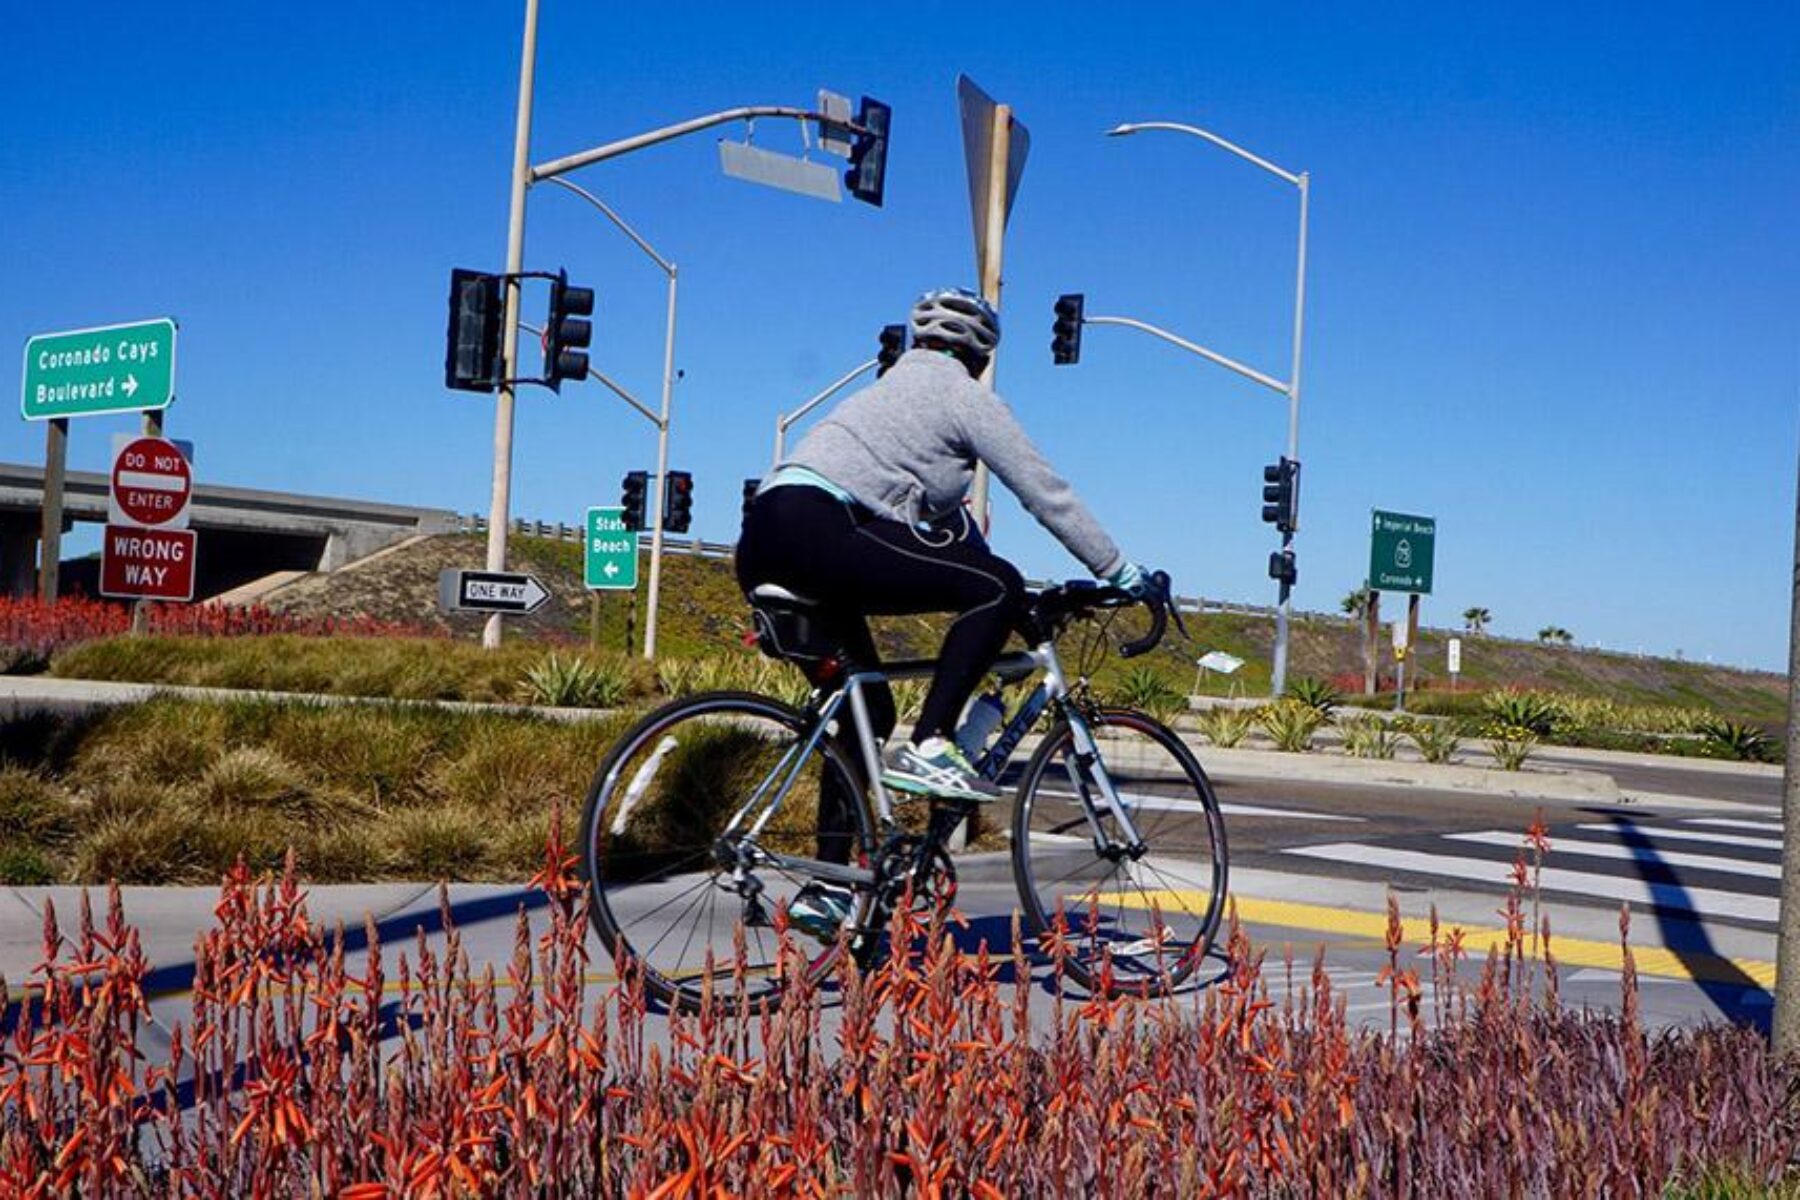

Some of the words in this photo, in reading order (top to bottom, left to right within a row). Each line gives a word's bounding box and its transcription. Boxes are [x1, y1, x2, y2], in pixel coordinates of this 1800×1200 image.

[39, 345, 110, 369] Coronado
[117, 340, 159, 363] Cays
[36, 376, 115, 404] Boulevard
[125, 453, 146, 468] DO
[154, 455, 180, 472] NOT
[127, 491, 173, 509] ENTER
[114, 537, 185, 562] WRONG
[593, 538, 631, 553] Beach
[124, 565, 168, 587] WAY
[469, 583, 496, 599] ONE
[499, 585, 527, 600] WAY
